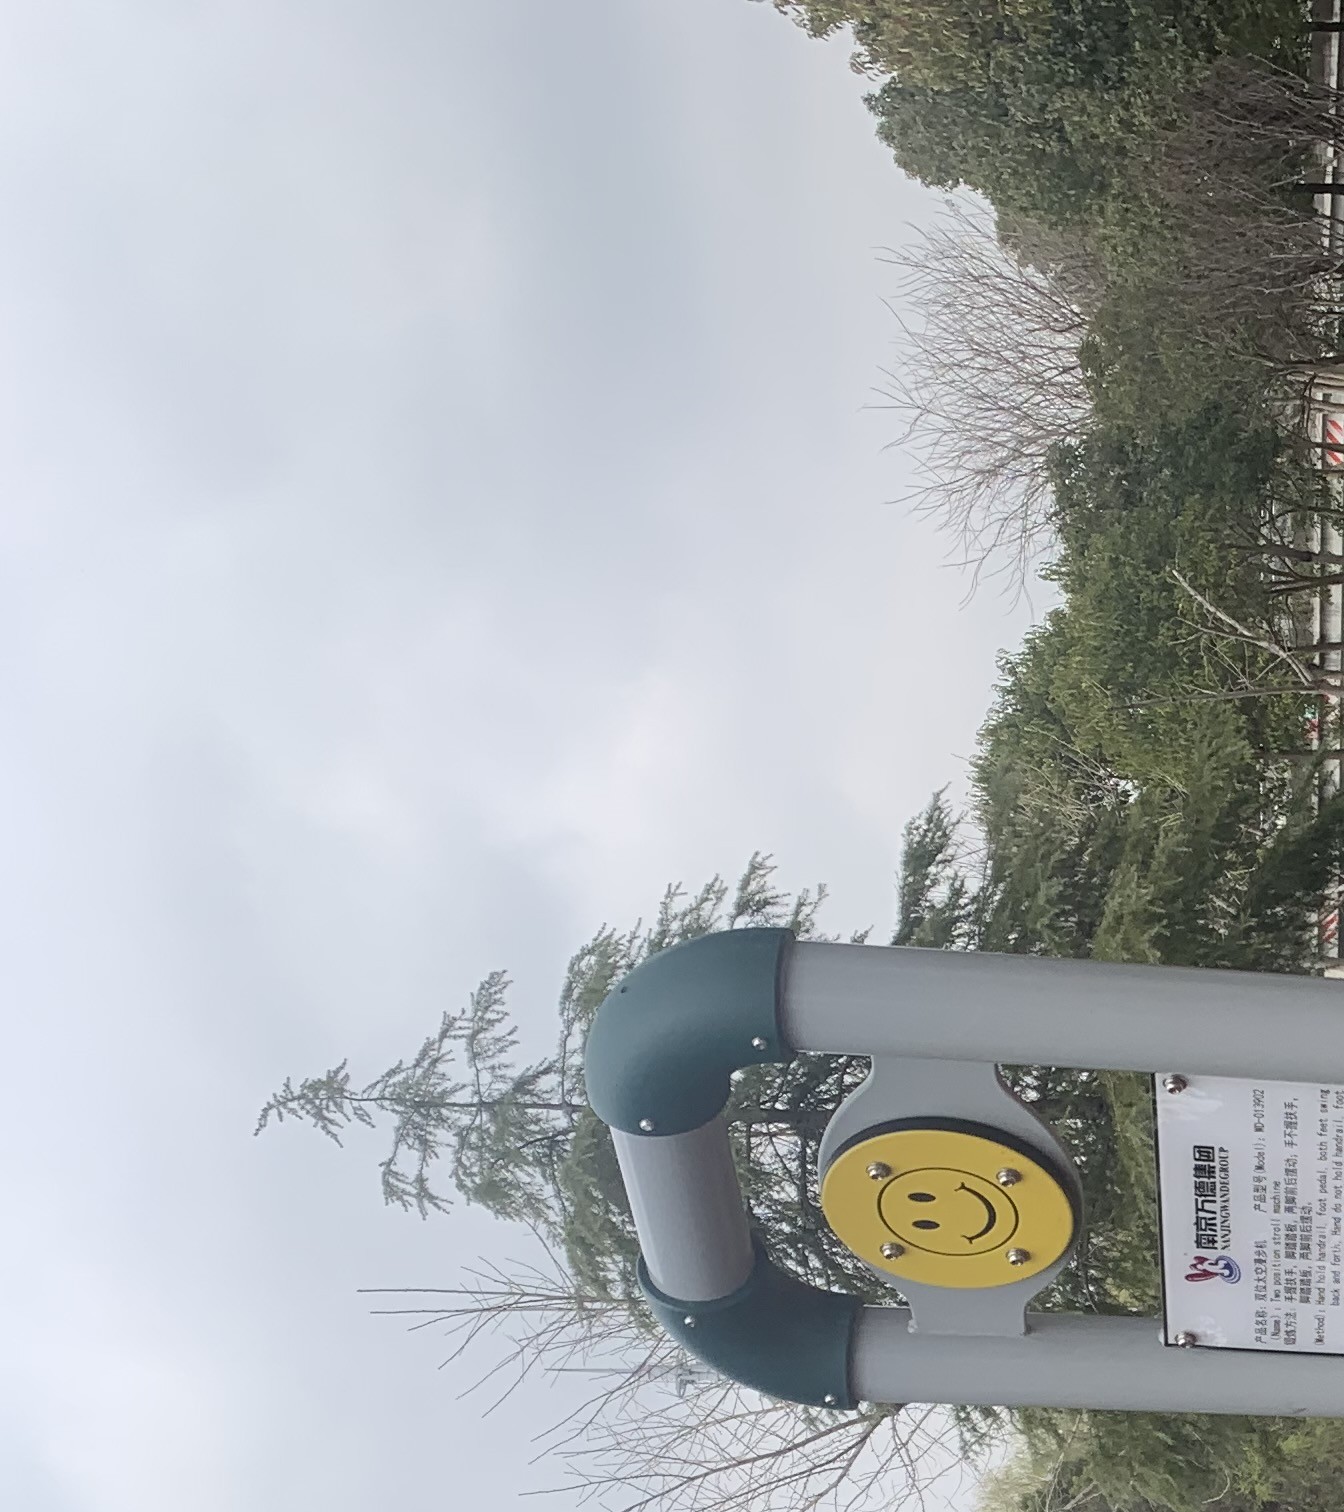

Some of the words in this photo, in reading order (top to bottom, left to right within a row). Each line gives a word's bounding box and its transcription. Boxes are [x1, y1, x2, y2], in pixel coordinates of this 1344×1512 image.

[1318, 1088, 1330, 1113] swing
[1333, 1089, 1344, 1109] foot
[1317, 1118, 1328, 1136] feet
[1317, 1141, 1327, 1161] both
[1331, 1160, 1343, 1180] hold
[1192, 1145, 1217, 1250] 南京万德集团
[1218, 1146, 1231, 1250] NANJINGWANDEGROUP
[1270, 1180, 1280, 1213] machine
[1332, 1185, 1342, 1199] not
[1315, 1197, 1326, 1215] foot
[1270, 1218, 1280, 1245] stroll
[1331, 1216, 1342, 1235] Hand
[1270, 1249, 1282, 1285] position
[1315, 1265, 1326, 1283] hold
[1330, 1270, 1340, 1284] and
[1270, 1289, 1280, 1302] Two
[1315, 1287, 1325, 1304] Hand
[1329, 1288, 1340, 1305] back
